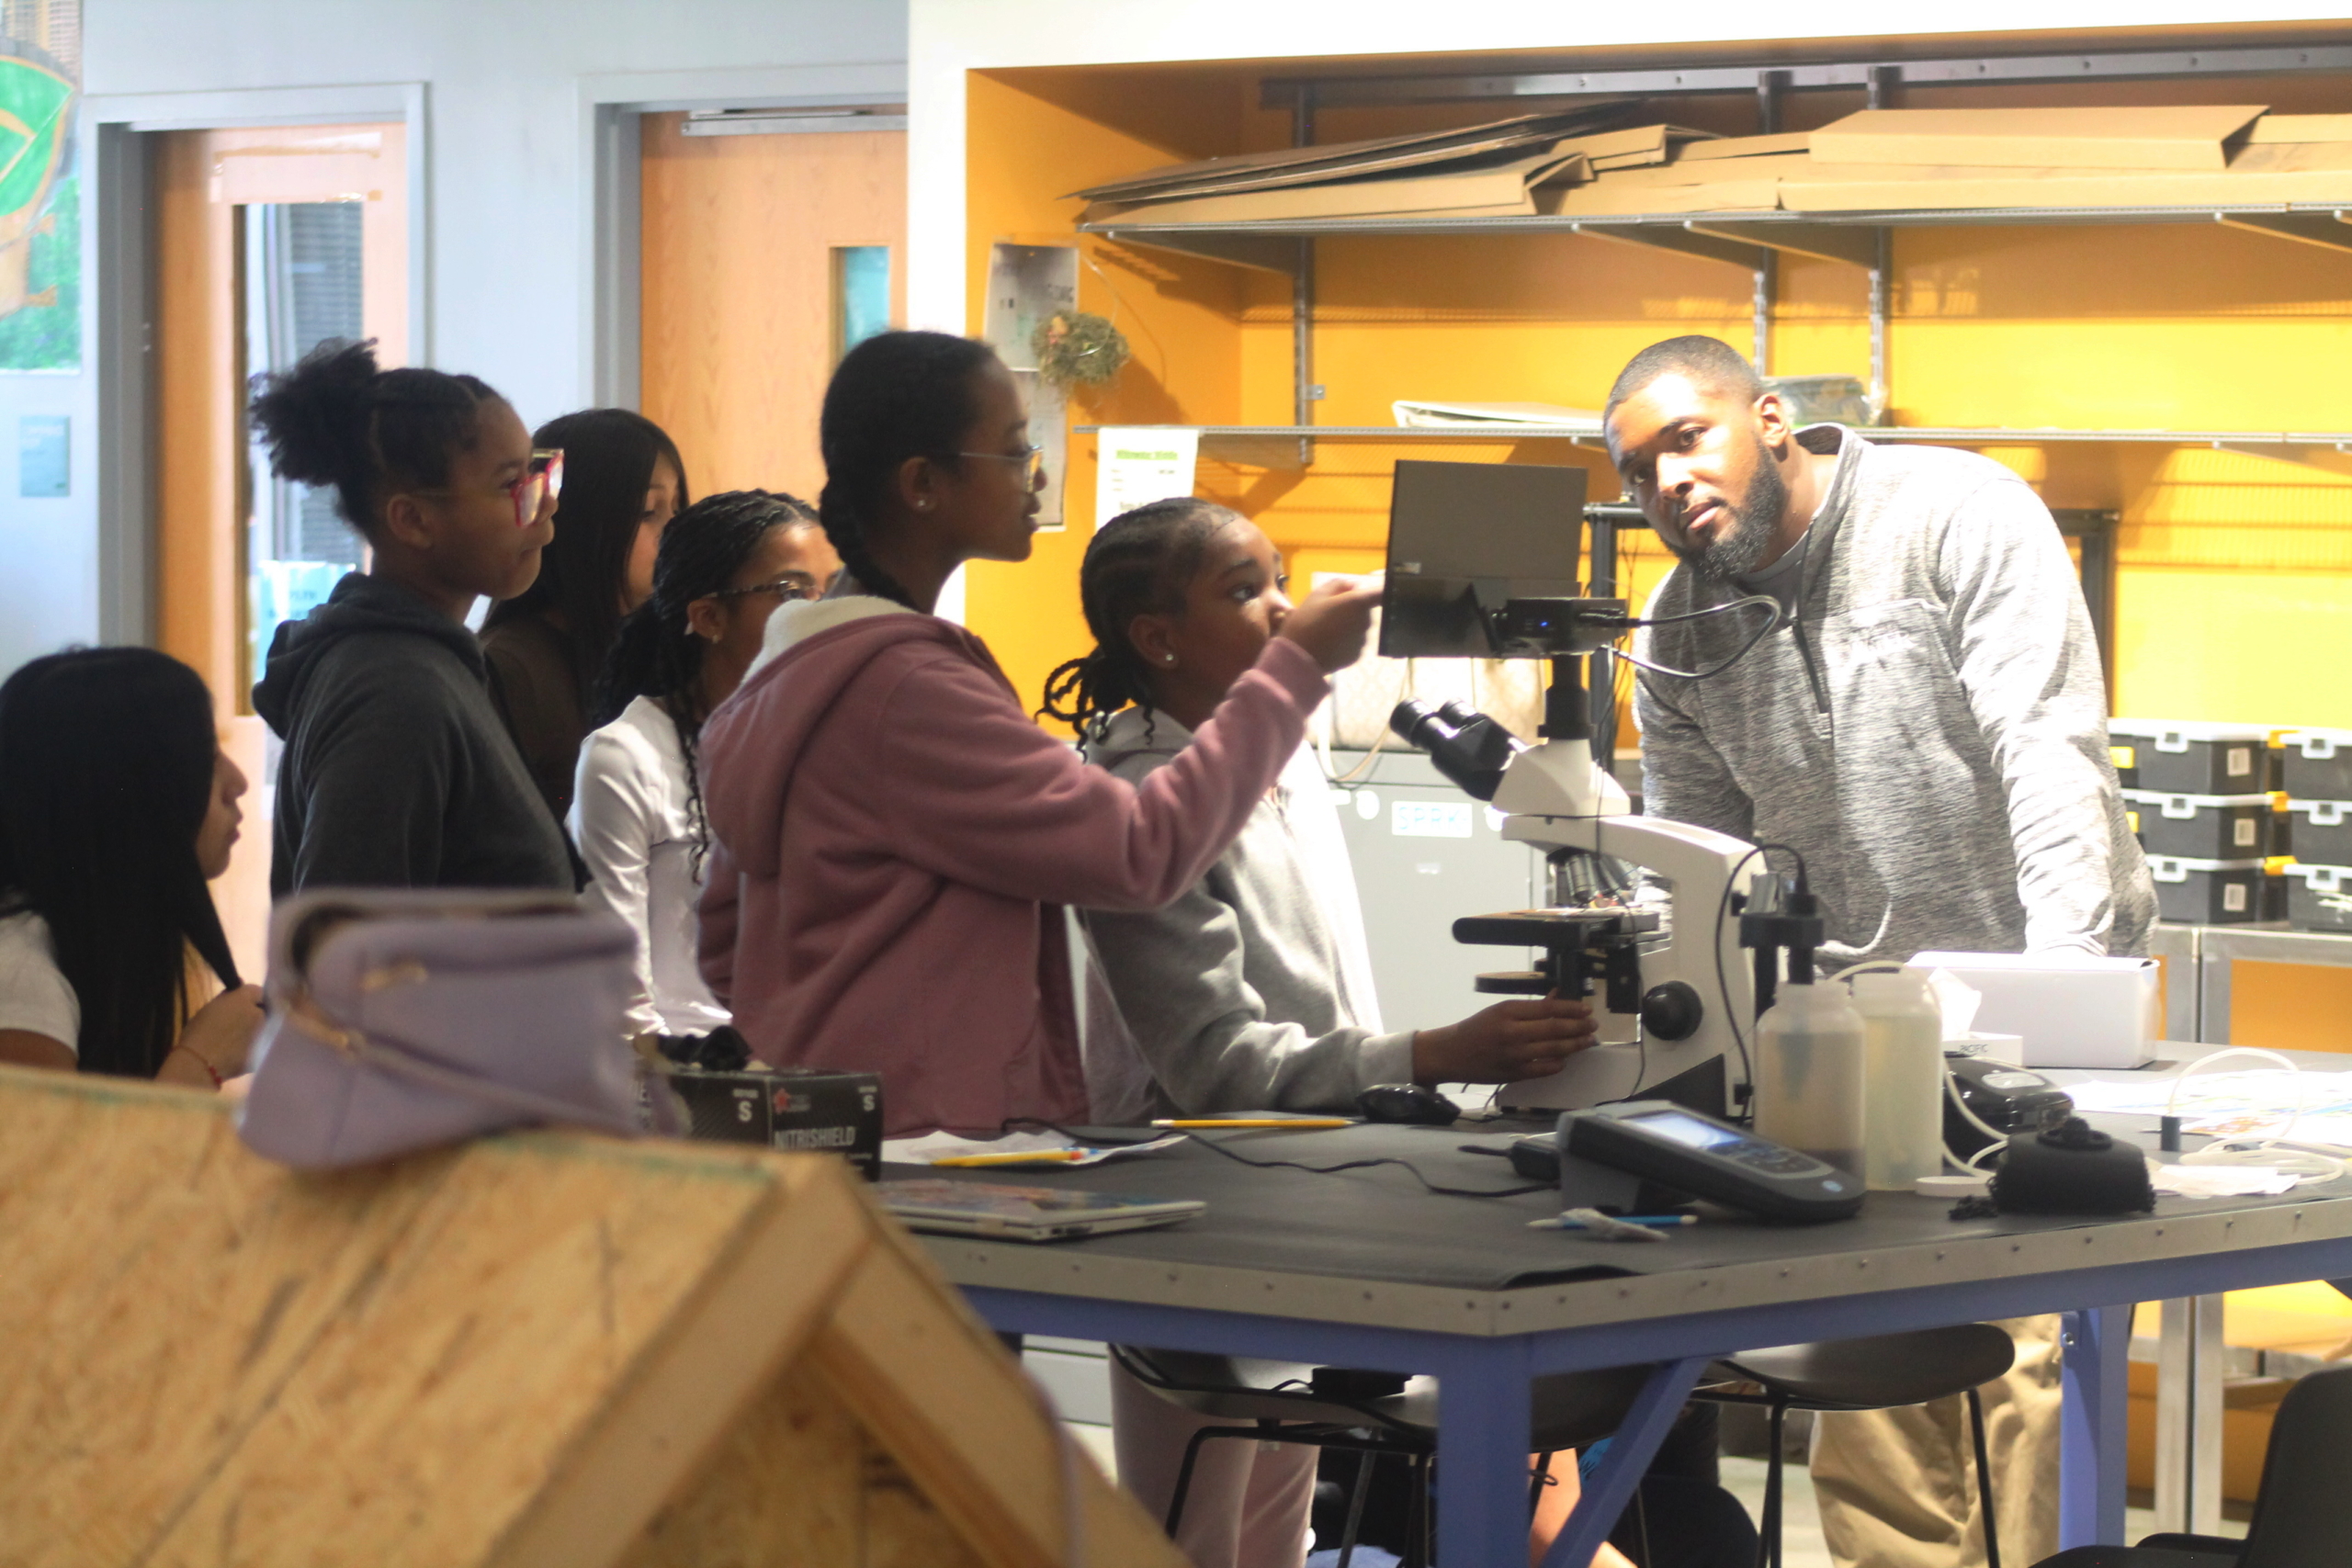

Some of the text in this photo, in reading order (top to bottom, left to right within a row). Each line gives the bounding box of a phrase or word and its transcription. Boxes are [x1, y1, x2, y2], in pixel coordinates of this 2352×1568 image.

[738, 1100, 752, 1122] S
[863, 1094, 875, 1111] S
[775, 1125, 856, 1150] NITRISHIELD
